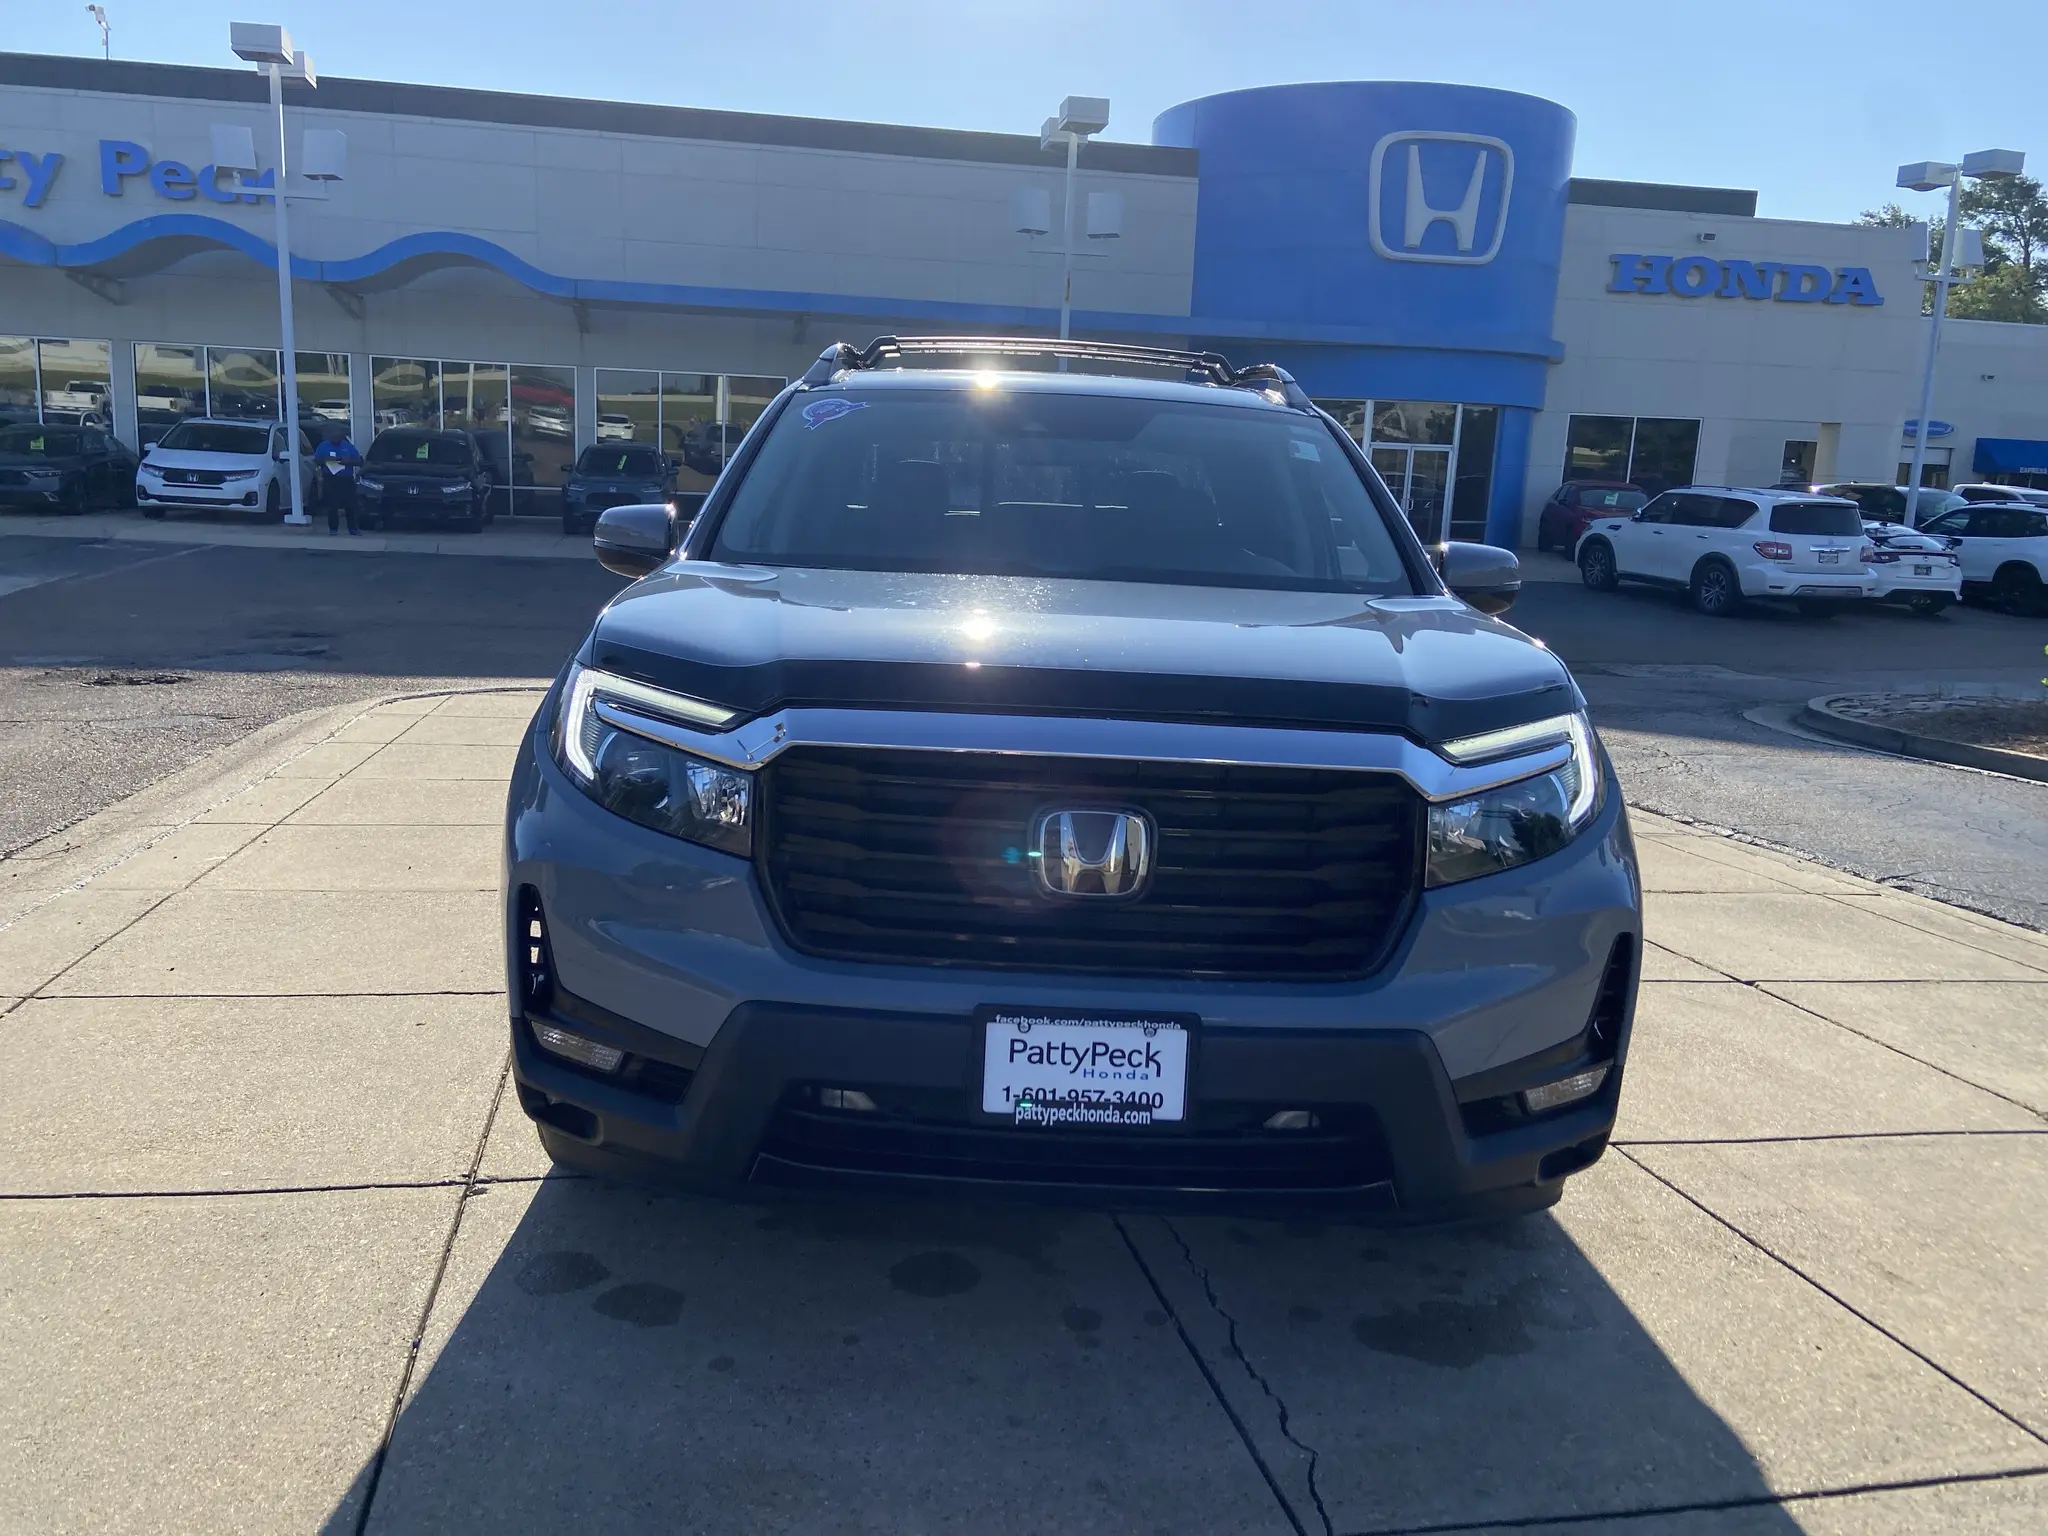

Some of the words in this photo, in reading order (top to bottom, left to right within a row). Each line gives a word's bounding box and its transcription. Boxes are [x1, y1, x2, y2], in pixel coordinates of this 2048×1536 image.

[1606, 254, 1884, 306] HONDA
[995, 1014, 1181, 1029] facebook.com/pattypeckhonda
[1009, 1038, 1162, 1077] PattyPeck
[1083, 1068, 1148, 1080] Honda
[1002, 1086, 1164, 1108] 1-601-957-3400
[1015, 1103, 1151, 1126] pattypeckhonda.com
